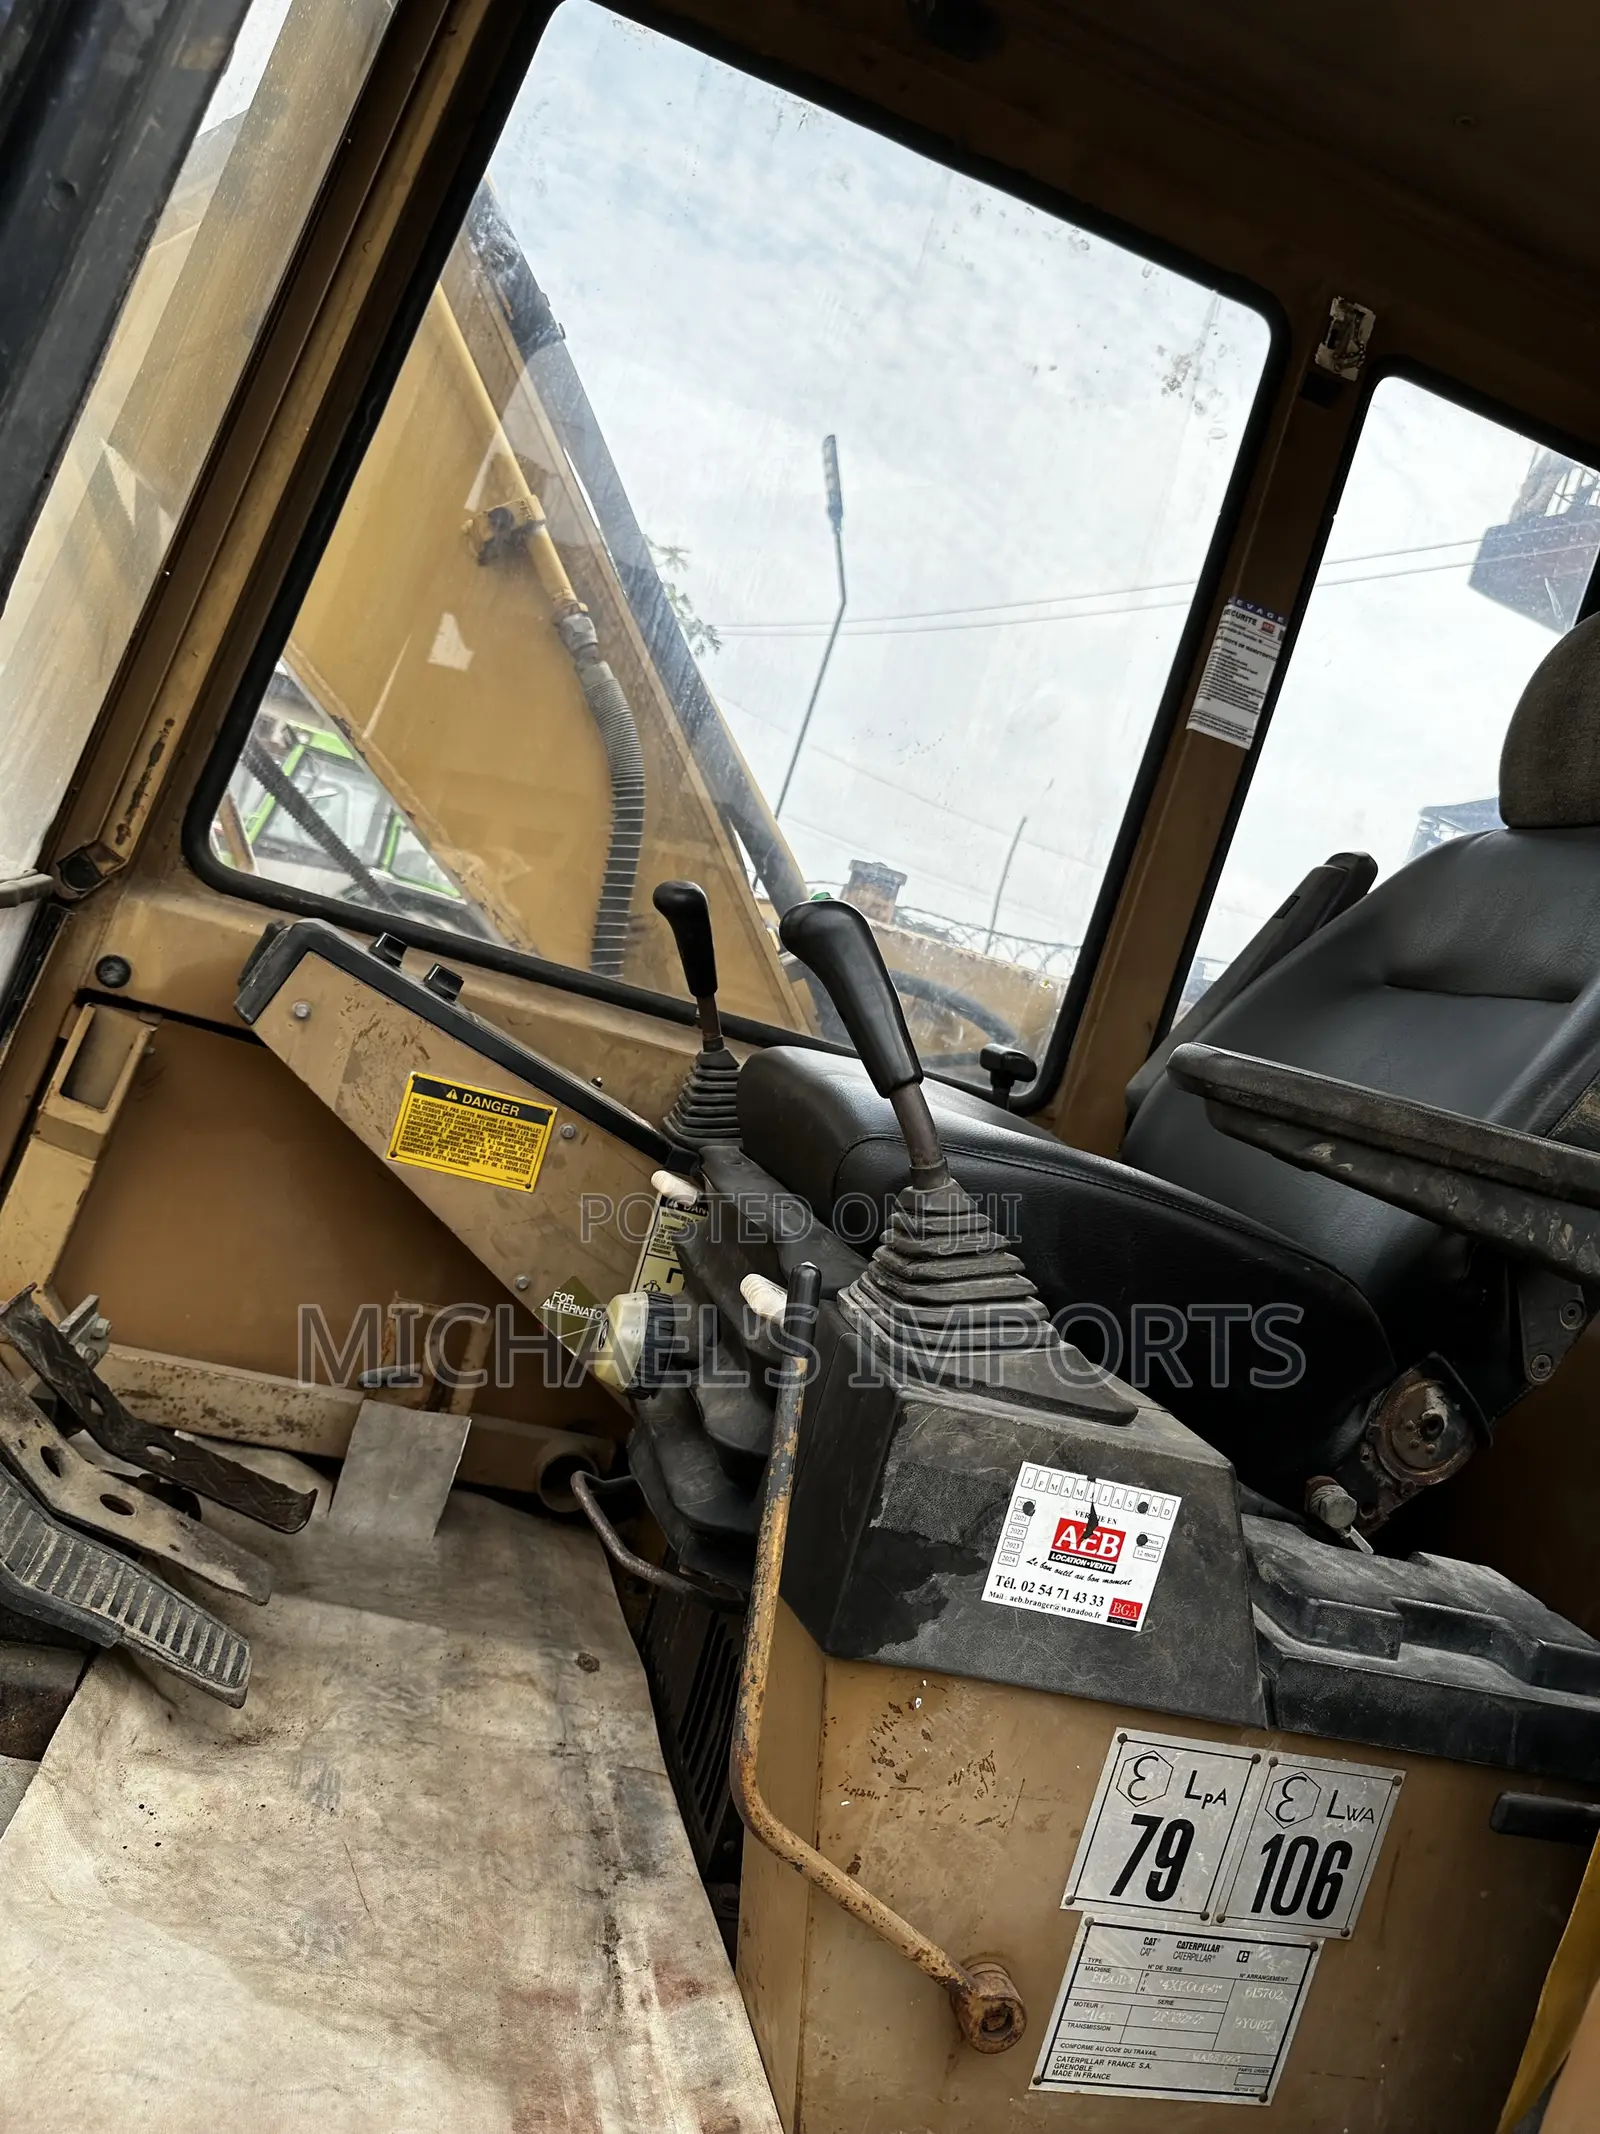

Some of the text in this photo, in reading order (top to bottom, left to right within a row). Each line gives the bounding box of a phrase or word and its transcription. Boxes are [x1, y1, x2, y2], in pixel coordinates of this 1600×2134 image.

[461, 1093, 520, 1116] DANGER
[552, 1291, 574, 1304] FOR
[543, 1298, 603, 1320] ALTERNATO
[1050, 1483, 1058, 1491] M
[1075, 1488, 1083, 1496] M
[1113, 1497, 1120, 1505] A
[1163, 1508, 1170, 1516] D
[1073, 1509, 1118, 1525] VERIE EN
[1009, 1527, 1024, 1536] 2022
[1053, 1523, 1123, 1560] AEB
[1000, 1555, 1015, 1563] 2024
[1025, 1555, 1039, 1566] Le
[1039, 1560, 1053, 1571] bon
[1053, 1565, 1073, 1577] outil
[1086, 1572, 1101, 1583] bon
[1101, 1573, 1132, 1589] moment
[988, 1590, 1004, 1599] Mail
[993, 1574, 1105, 1607] Tél. 02 54 71 43 33
[1110, 1601, 1140, 1618] BGA
[1109, 1813, 1195, 1902] 79
[1250, 1833, 1353, 1920] 106
[1084, 1965, 1111, 1973] MACHINE
[1246, 1973, 1288, 1982] ARRANGEMENT
[1066, 2022, 1111, 2031] TRANSMISSION
[1059, 2042, 1094, 2051] CONFORME
[1132, 2048, 1157, 2056] TRAVAIL
[1053, 2062, 1093, 2071] GRENOBLE
[1055, 2055, 1105, 2065] CATERPILLAR
[1106, 2059, 1136, 2068] FRANCE
[1051, 2069, 1072, 2077] MADE
[1081, 2071, 1111, 2080] FRANCE
